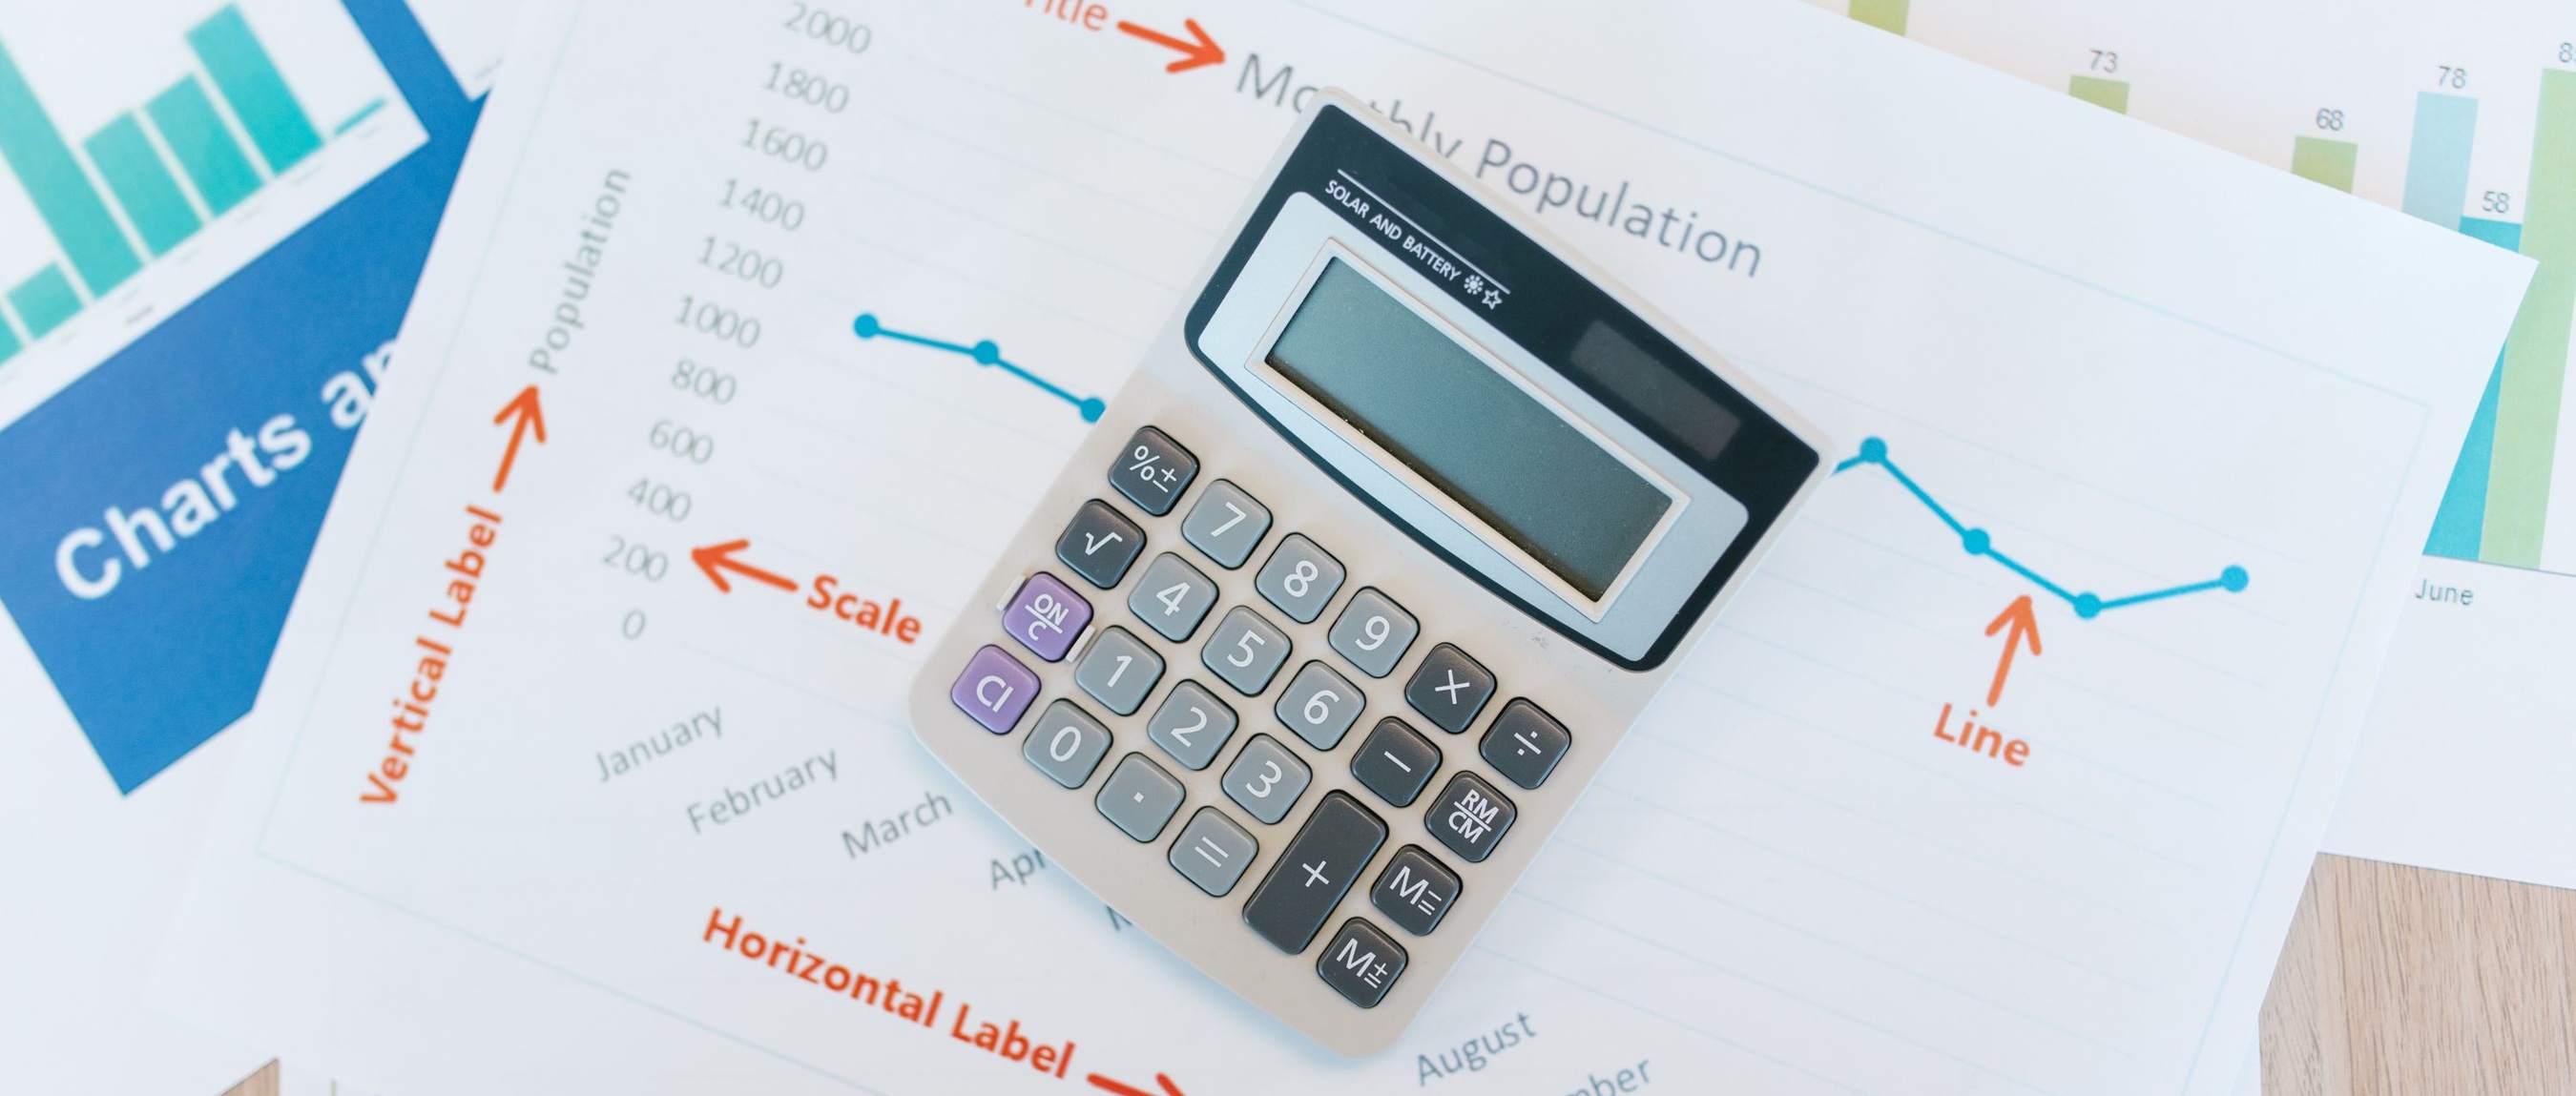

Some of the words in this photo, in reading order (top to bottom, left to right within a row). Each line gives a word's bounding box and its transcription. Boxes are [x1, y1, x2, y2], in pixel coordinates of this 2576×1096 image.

[783, 1, 873, 54] 2000
[1025, 0, 1109, 31] tle
[2090, 49, 2118, 73] 73
[2558, 41, 2576, 63] 8
[765, 62, 850, 114] 1800
[2439, 65, 2466, 90] 78
[2316, 108, 2344, 132] 68
[743, 118, 828, 171] 1600
[721, 178, 805, 231] 1400
[1476, 138, 1761, 278] Population
[2482, 190, 2509, 214] 58
[1324, 179, 1370, 218] SOLAR
[1369, 205, 1402, 240] AND
[1402, 235, 1462, 281] BATTERY
[529, 170, 630, 375] Population
[698, 236, 784, 289] 1200
[677, 296, 761, 348] 1000
[672, 360, 737, 403] 800
[650, 421, 714, 464] 600
[55, 415, 311, 599] Charts
[628, 479, 692, 521] 400
[1210, 501, 1248, 538] 7
[603, 538, 669, 581] 200
[1283, 559, 1319, 599] 8
[806, 576, 922, 645] Scale
[1033, 593, 1070, 627] ON
[1154, 581, 1192, 617] 4
[2415, 579, 2474, 607] June
[621, 609, 647, 641] 0
[1028, 620, 1048, 642] C
[1355, 615, 1390, 651] 9
[360, 636, 452, 804] Vertical
[429, 505, 502, 628] Label
[1226, 630, 1266, 668] 5
[1106, 654, 1133, 689] 1
[1171, 706, 1207, 747] 2
[1303, 690, 1340, 725] 6
[596, 707, 722, 782] January
[1049, 726, 1082, 762] 0
[1934, 703, 2030, 767] Line
[686, 751, 837, 834] February
[1245, 760, 1282, 799] 3
[841, 792, 953, 858] March
[1460, 788, 1500, 824] RM
[1447, 811, 1485, 844] CM
[703, 907, 944, 1028] Horizontal
[951, 1003, 1075, 1079] Label
[1417, 1013, 1536, 1086] August
[1565, 1060, 1650, 1096] ber
